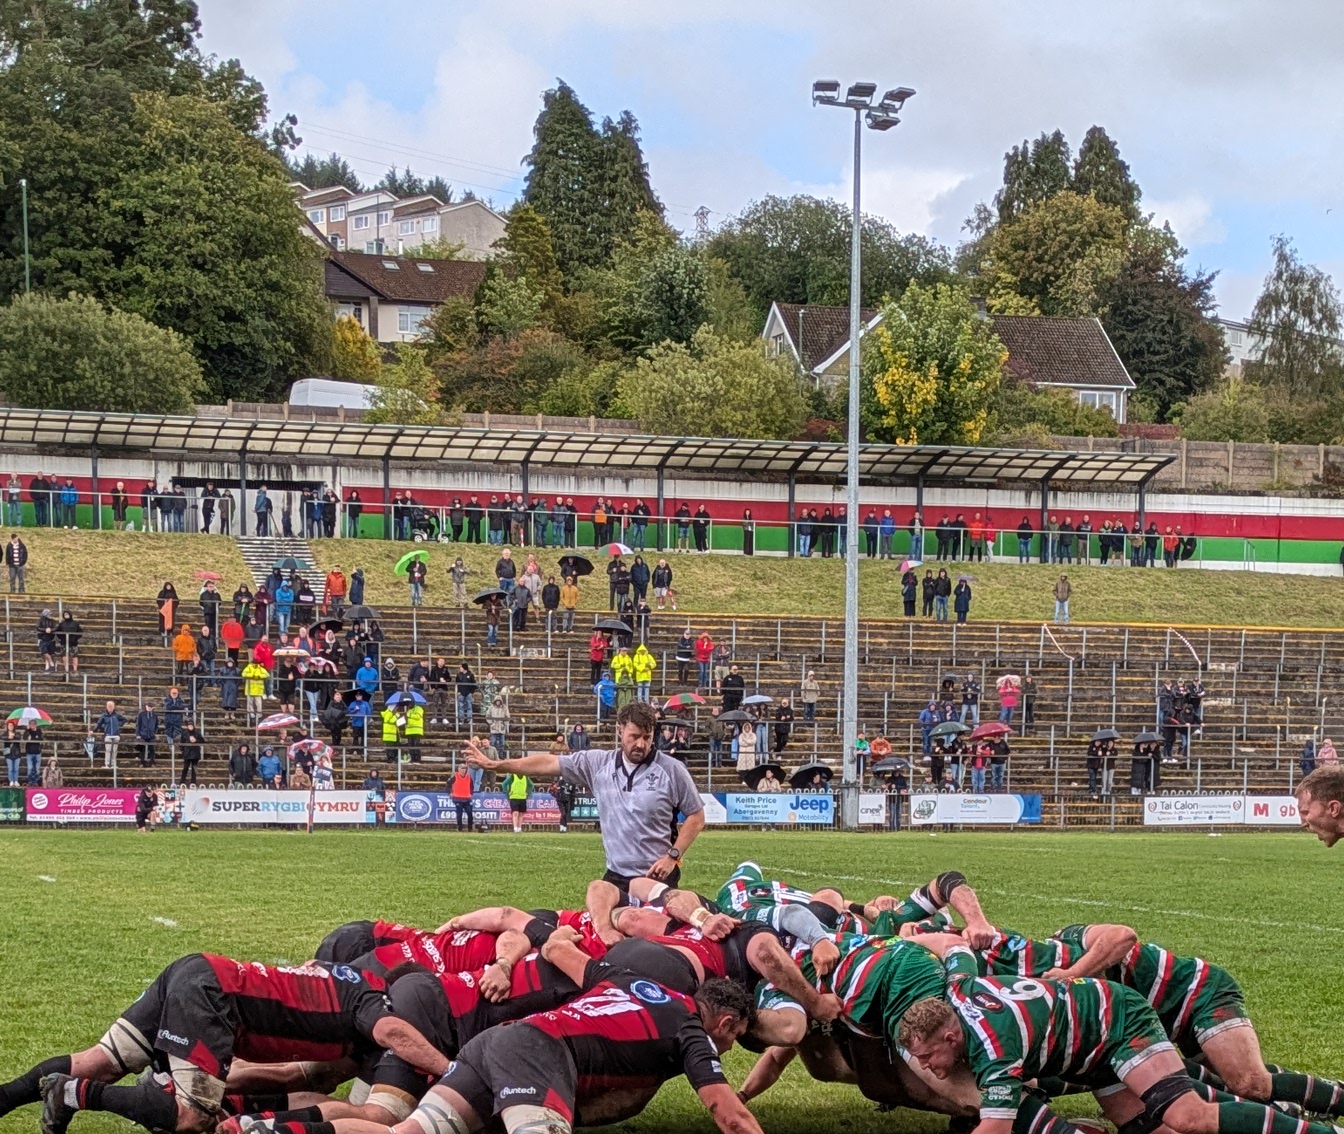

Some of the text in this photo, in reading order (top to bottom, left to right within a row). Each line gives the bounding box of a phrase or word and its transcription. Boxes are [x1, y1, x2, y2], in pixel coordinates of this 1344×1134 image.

[58, 793, 91, 809] Philip
[92, 793, 124, 808] Jones
[578, 797, 597, 805] TRUS
[735, 796, 777, 804] Keith Price
[789, 795, 829, 813] Jeep
[1160, 801, 1172, 810] Tai
[1174, 801, 1199, 810] Calon
[1253, 803, 1296, 817] M gb
[798, 814, 829, 822] Motability
